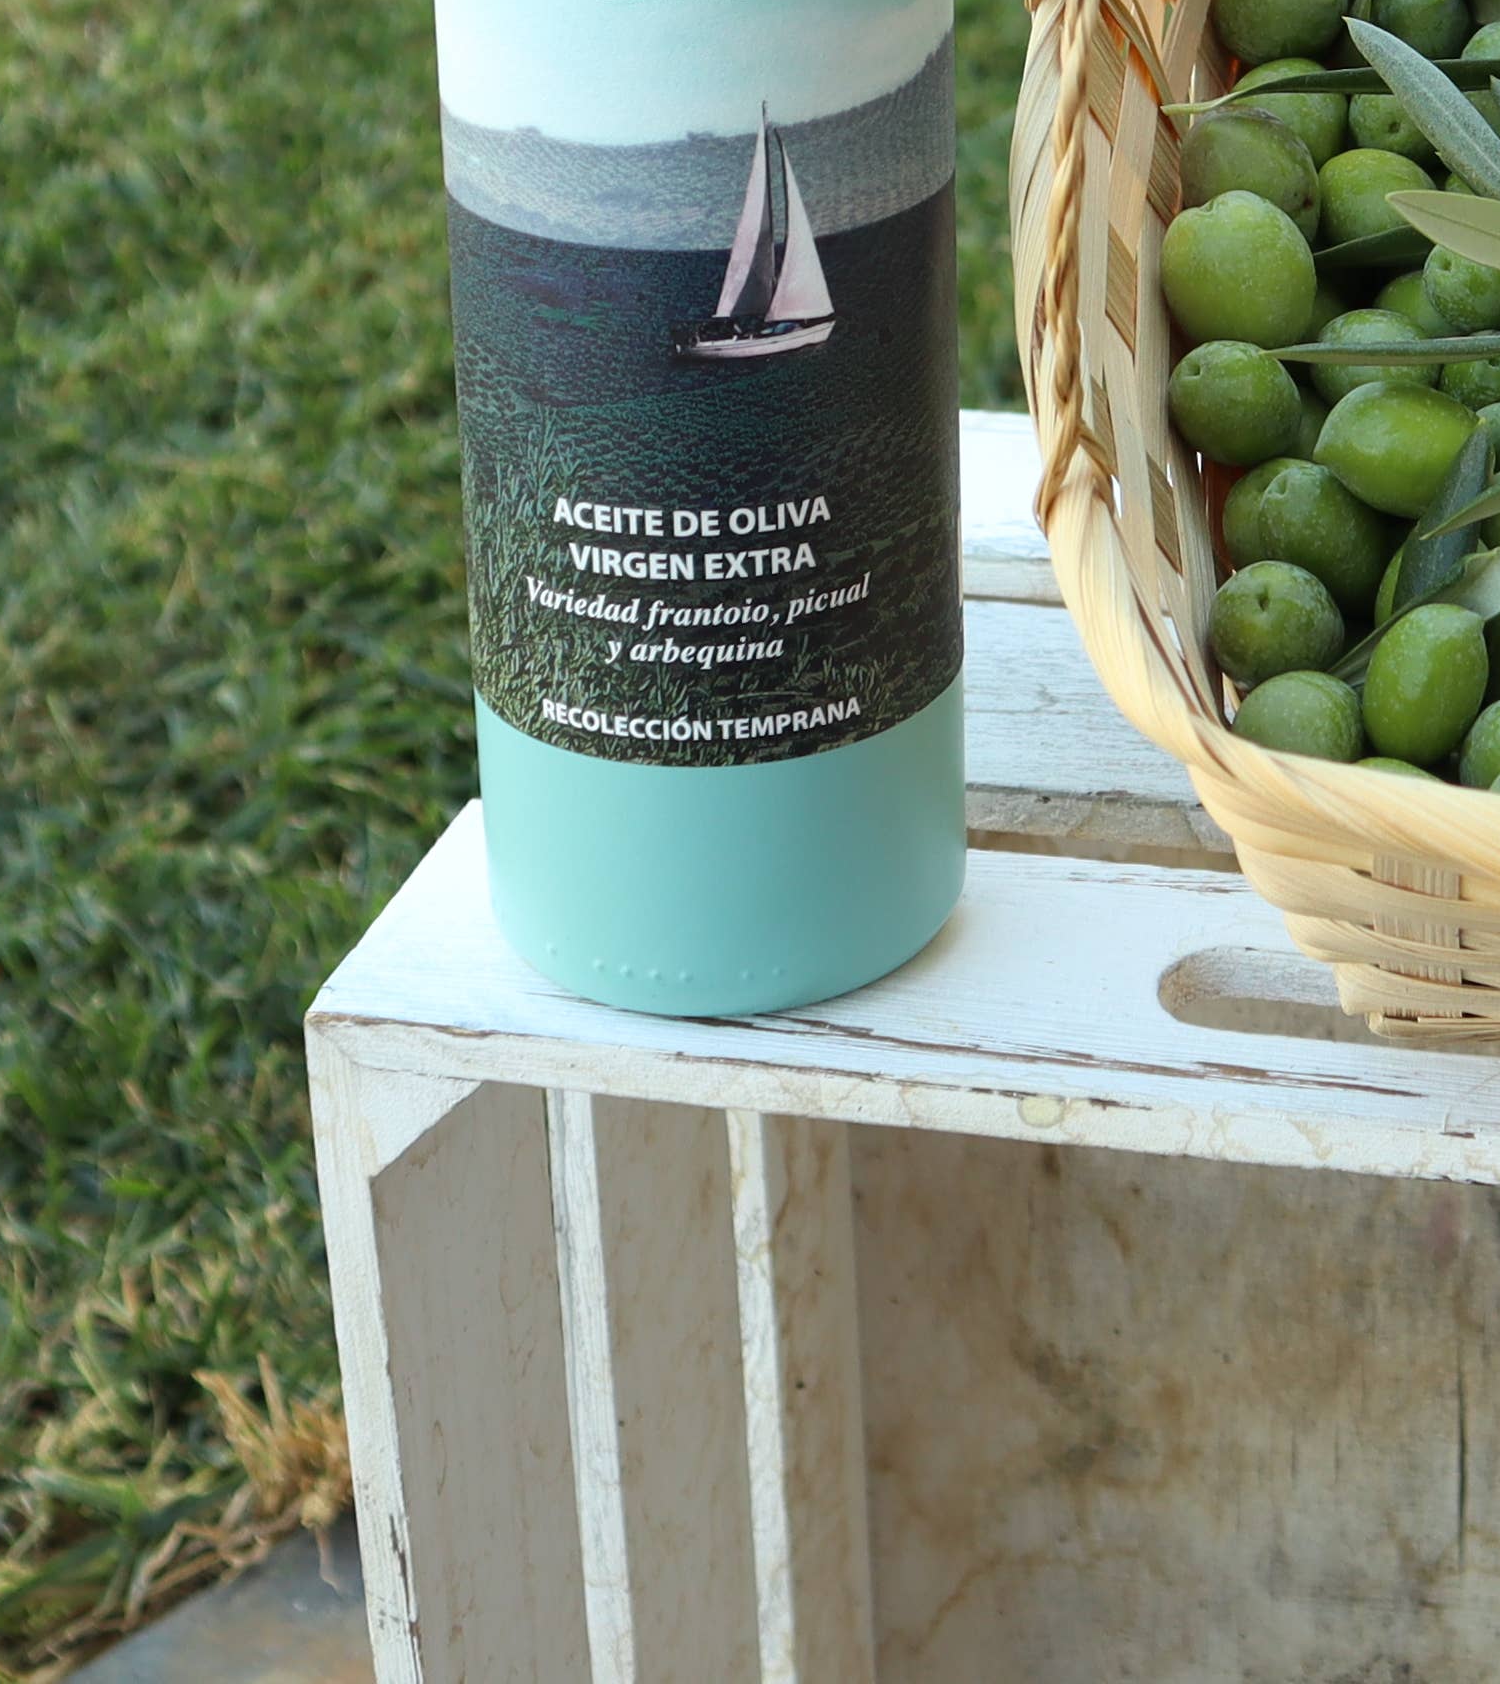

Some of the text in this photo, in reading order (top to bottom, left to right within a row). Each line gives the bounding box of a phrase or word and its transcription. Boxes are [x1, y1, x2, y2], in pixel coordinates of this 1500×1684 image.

[553, 495, 831, 538] ACEITE DE OLIVA
[568, 542, 816, 581] VIRGEN EXTRA
[525, 572, 872, 631] Variedad frantoio, picual
[604, 636, 785, 670] y arbequina
[542, 697, 861, 741] RECOLECCIÓN TEMPRANA
